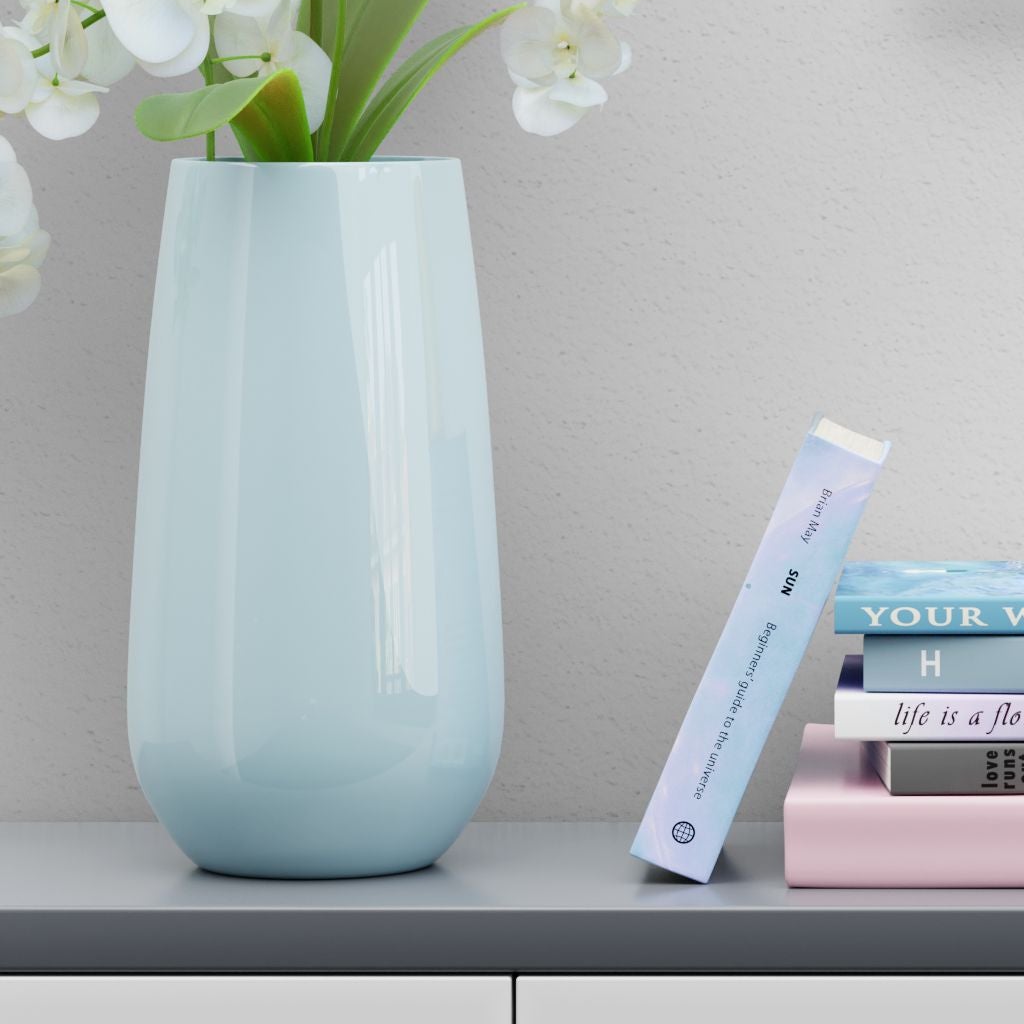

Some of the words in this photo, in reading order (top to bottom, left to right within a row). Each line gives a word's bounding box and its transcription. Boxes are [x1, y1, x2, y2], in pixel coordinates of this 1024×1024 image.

[813, 488, 833, 517] Brian
[800, 520, 819, 544] May
[780, 568, 799, 596] SUN
[860, 606, 988, 627] YOUR
[745, 622, 777, 682] Beginners'
[729, 681, 749, 714] guide
[723, 716, 735, 728] to
[894, 702, 930, 735] life
[940, 706, 958, 726] is
[968, 711, 984, 726] a
[714, 731, 729, 750] the
[693, 753, 719, 800] universe
[981, 750, 999, 788] love
[1003, 748, 1016, 789] runs
